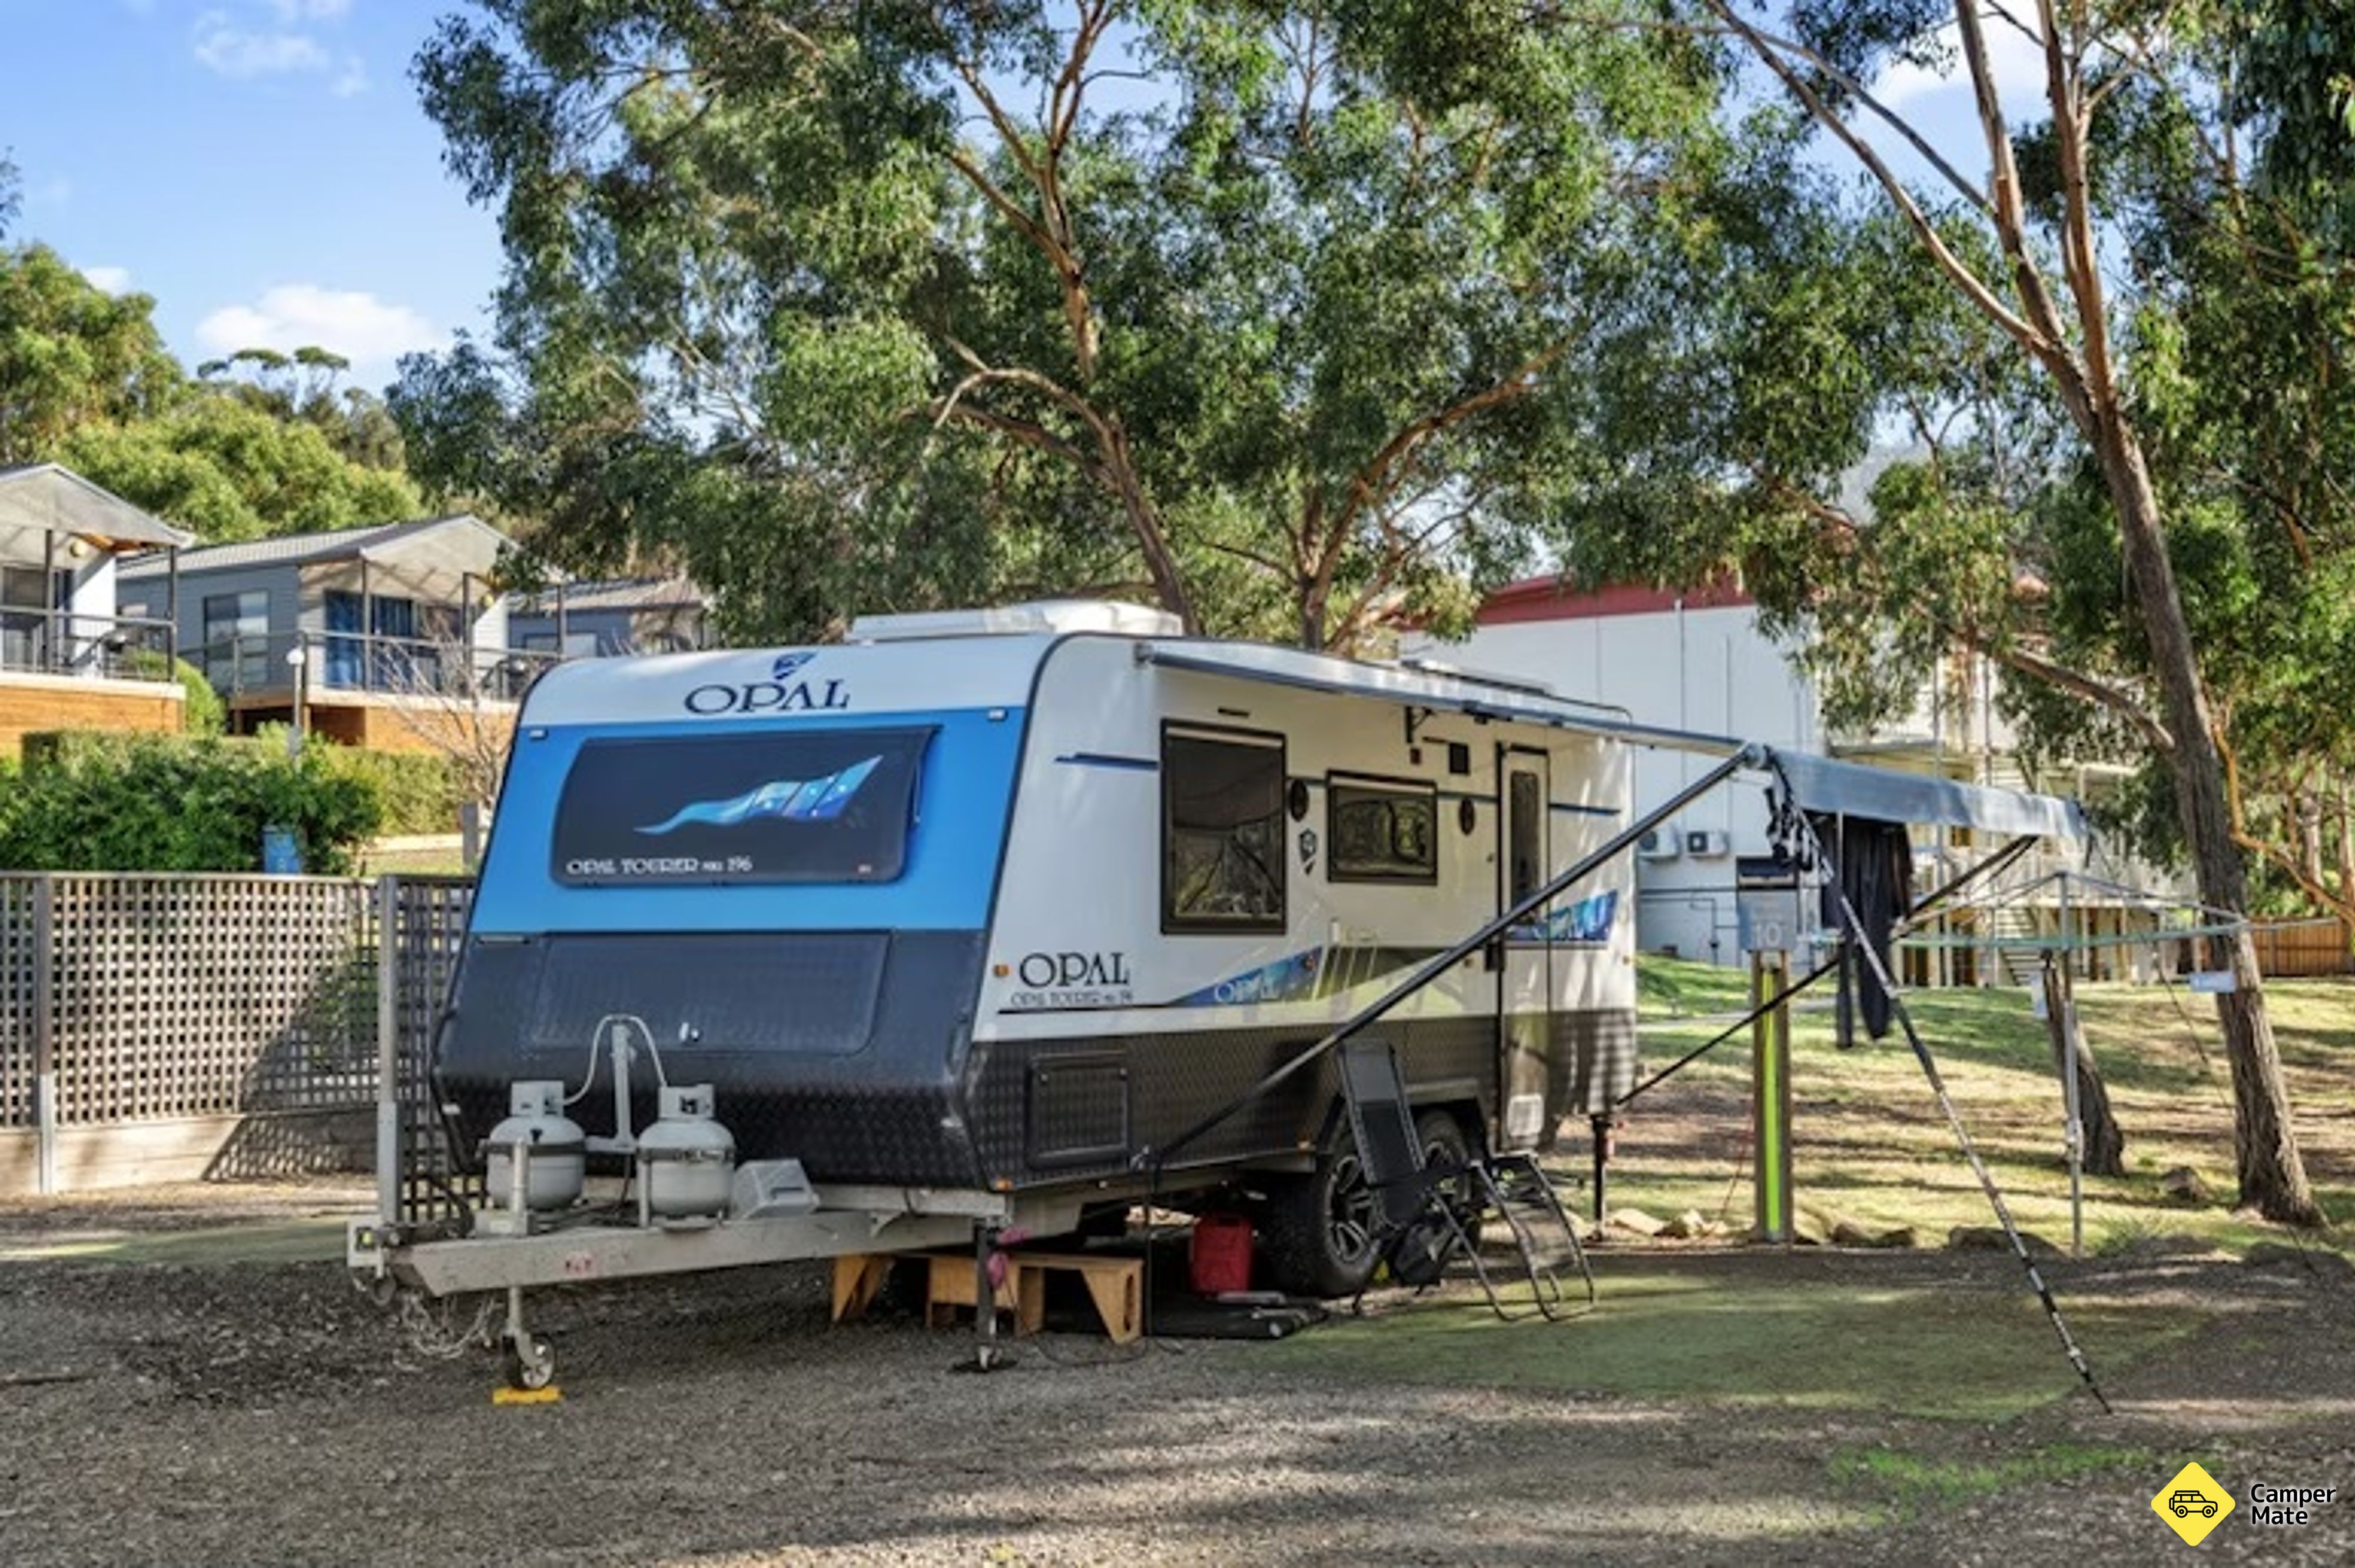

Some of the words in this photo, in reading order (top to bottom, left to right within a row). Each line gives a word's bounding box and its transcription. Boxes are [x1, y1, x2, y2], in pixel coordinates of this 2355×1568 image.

[685, 679, 850, 715] OPAL
[566, 858, 616, 874] OPAL
[1020, 952, 1130, 987] OPAL
